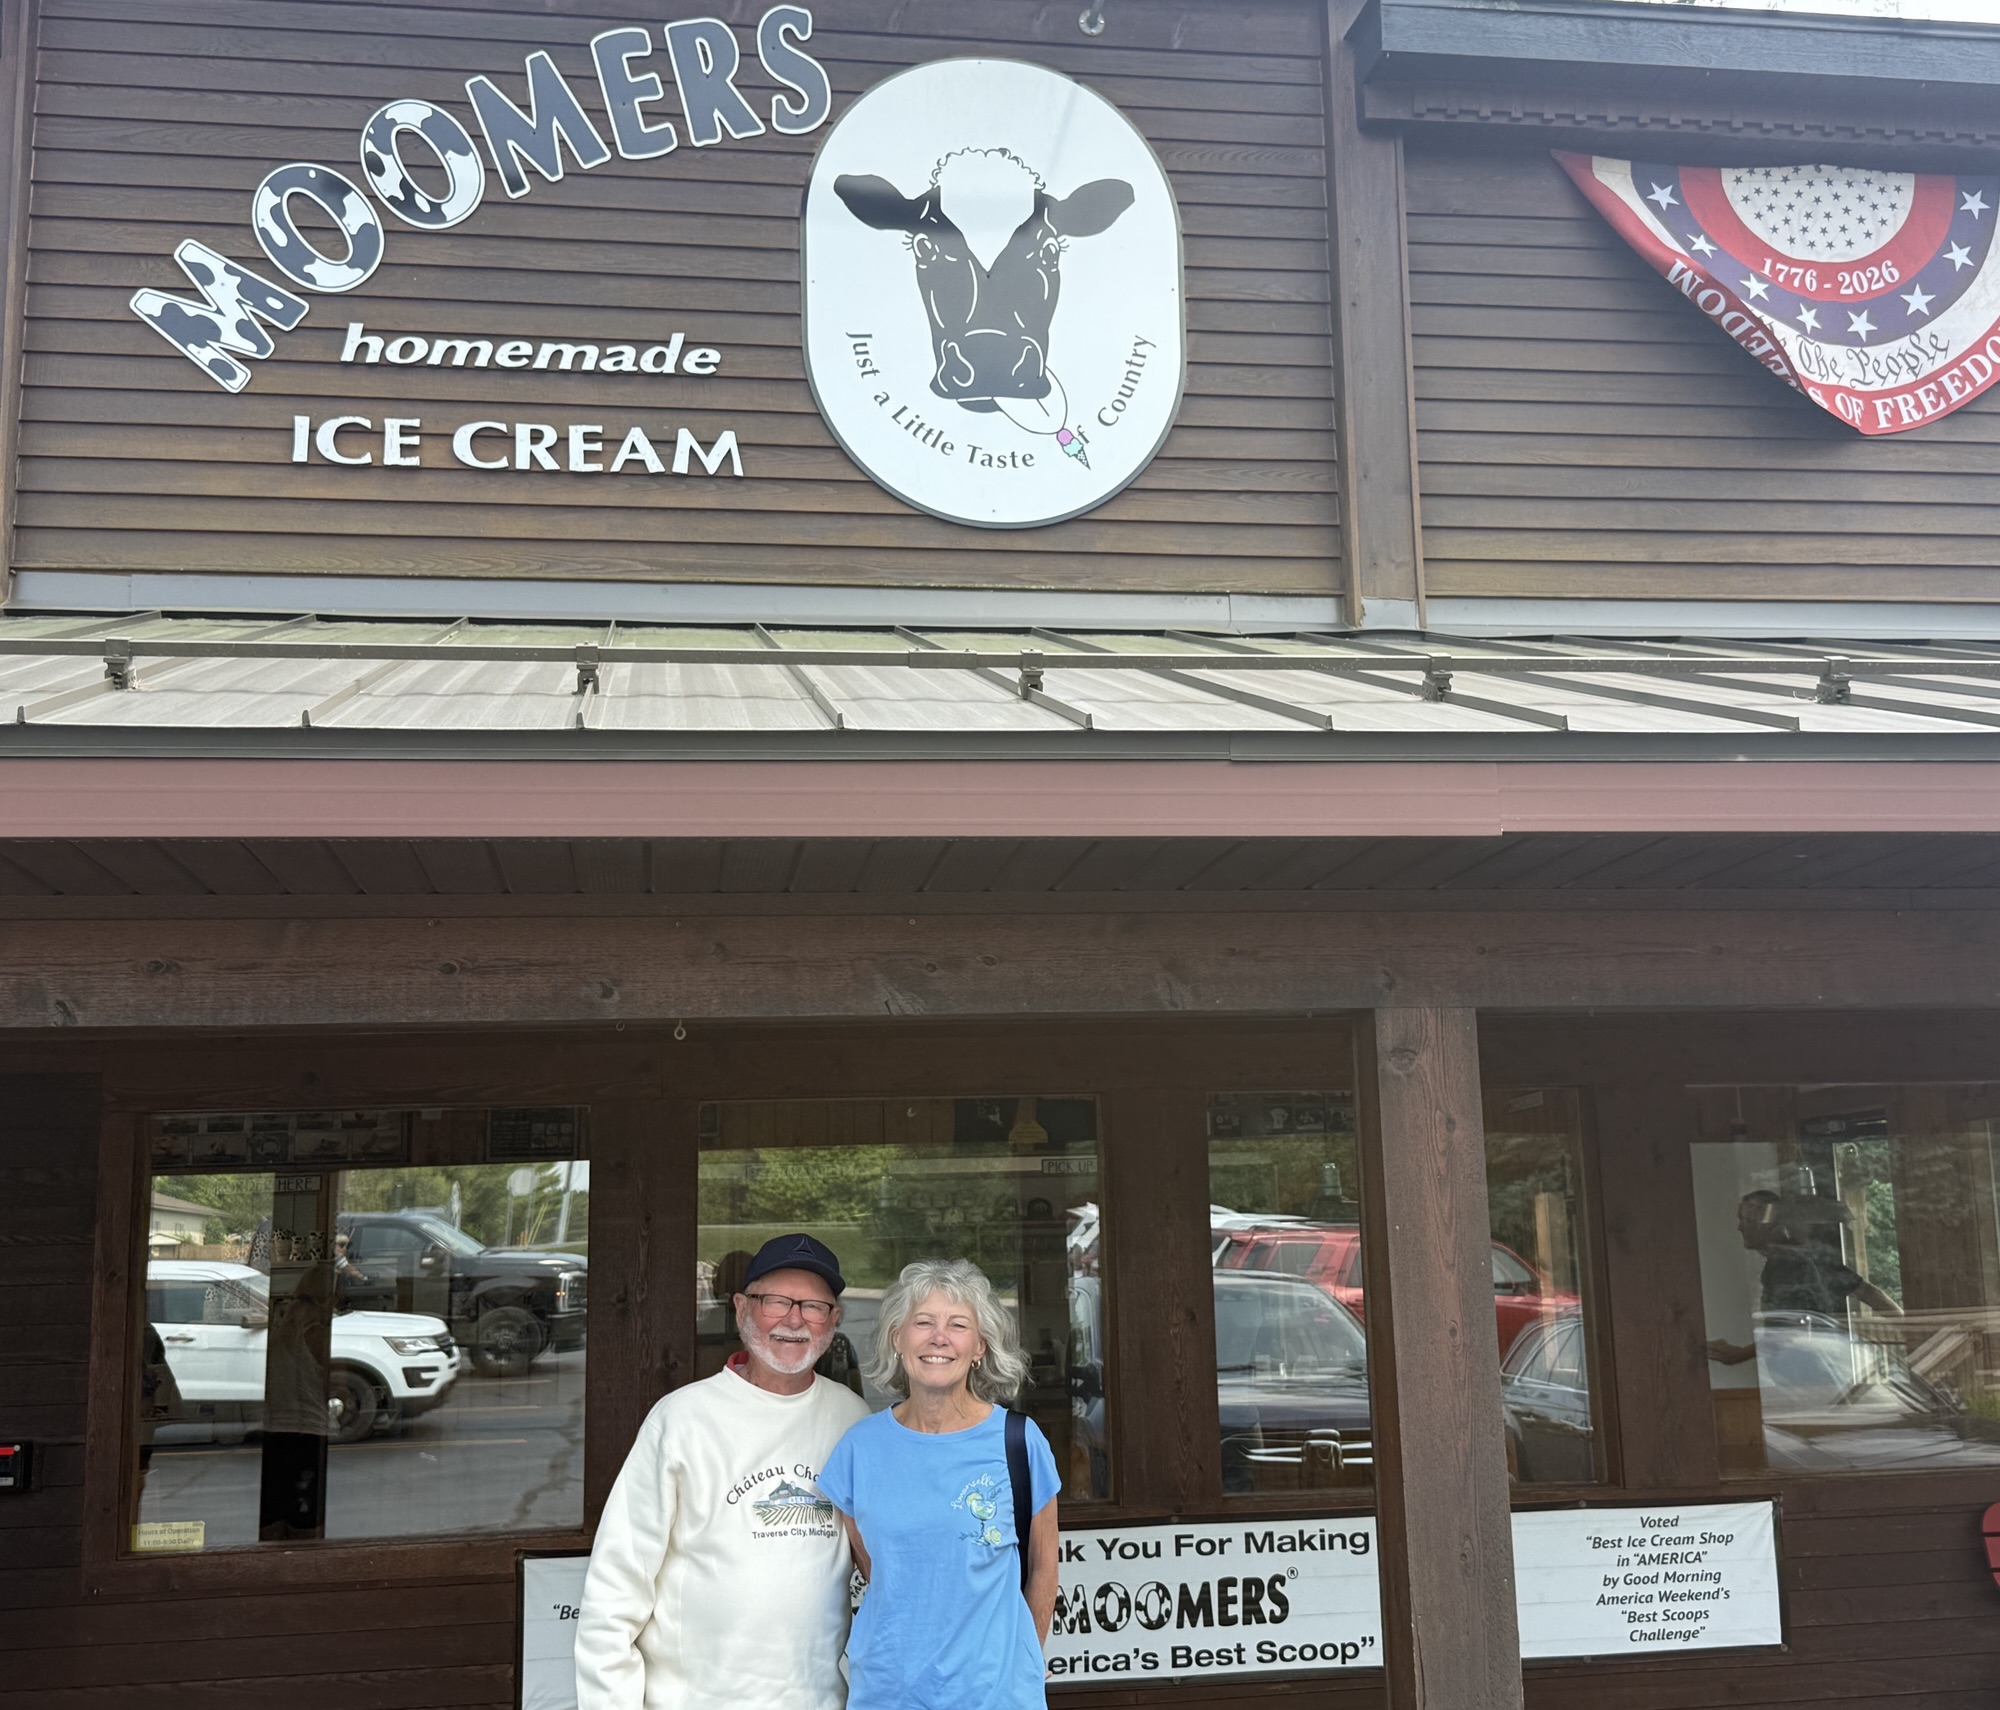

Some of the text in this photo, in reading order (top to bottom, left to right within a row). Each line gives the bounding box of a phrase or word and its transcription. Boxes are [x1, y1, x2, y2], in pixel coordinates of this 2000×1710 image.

[129, 4, 832, 393] MOOMERS
[1760, 257, 1817, 292] 1776
[1837, 259, 1900, 295] 2026
[340, 322, 722, 375] homemade
[1796, 334, 1845, 384] The
[1846, 332, 1950, 389] People
[1835, 392, 1865, 426] OF
[1872, 326, 2000, 429] FREEDO
[846, 332, 881, 379] Just
[873, 391, 890, 407] a
[891, 405, 955, 456] Little
[967, 444, 1035, 469] Taste
[1097, 334, 1157, 428] Country
[292, 415, 744, 477] ICE CREAM
[1047, 1160, 1093, 1173] PICK UP
[278, 1177, 313, 1192] HERE
[726, 1466, 785, 1505] Château
[752, 1529, 789, 1539] Traverse
[809, 1527, 839, 1539] Michigan
[1640, 1515, 1680, 1529] Voted
[1096, 1535, 1161, 1561] You
[1174, 1531, 1232, 1557] For
[1244, 1529, 1370, 1555] Making
[1627, 1535, 1646, 1548] Ice
[1650, 1534, 1695, 1547] Cream
[1699, 1532, 1734, 1546] Shop
[1616, 1555, 1630, 1567] in
[1602, 1570, 1722, 1589] by Good Morning
[1596, 1587, 1730, 1606] America Weekend’s
[553, 1604, 580, 1620] “Be
[1662, 1608, 1710, 1623] Scoops
[1048, 1648, 1159, 1675] erica’s
[1171, 1643, 1246, 1669] Best
